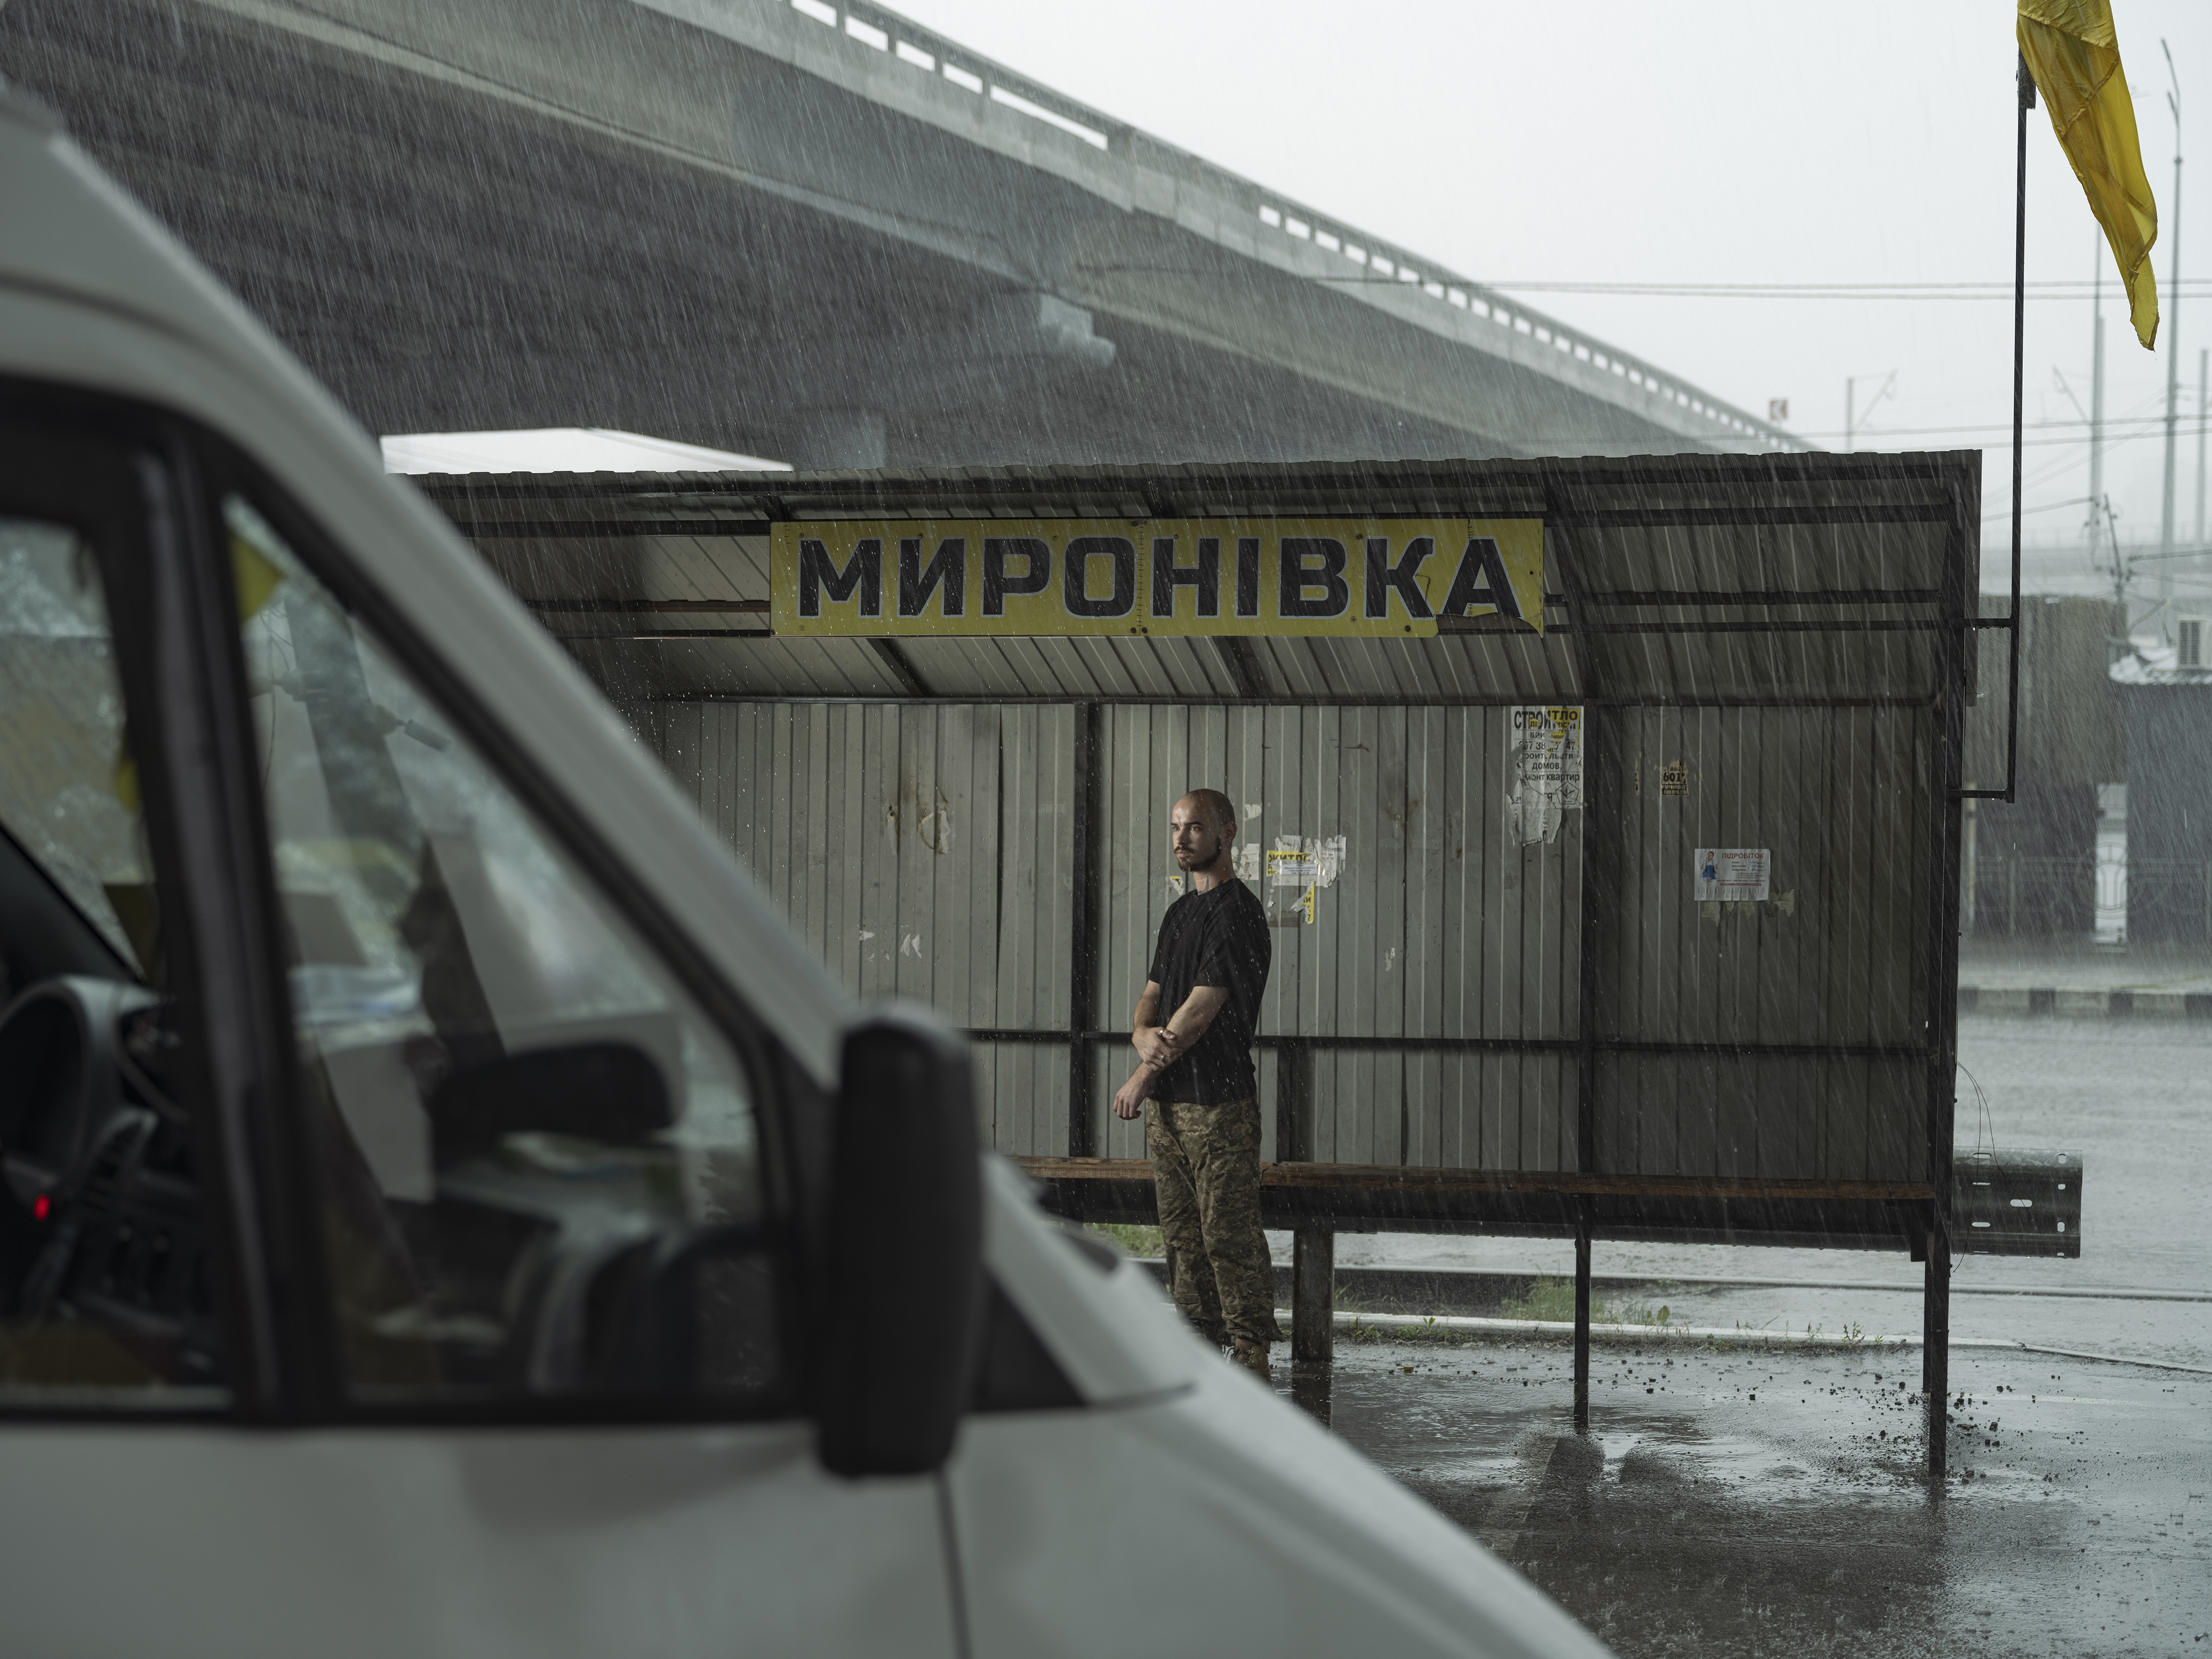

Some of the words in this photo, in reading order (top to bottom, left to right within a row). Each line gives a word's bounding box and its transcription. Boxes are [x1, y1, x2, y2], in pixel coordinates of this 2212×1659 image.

[797, 535, 1525, 620] МИРОНІВКА
[1532, 763, 1562, 771] домов,
[1546, 773, 1580, 782] квартир
